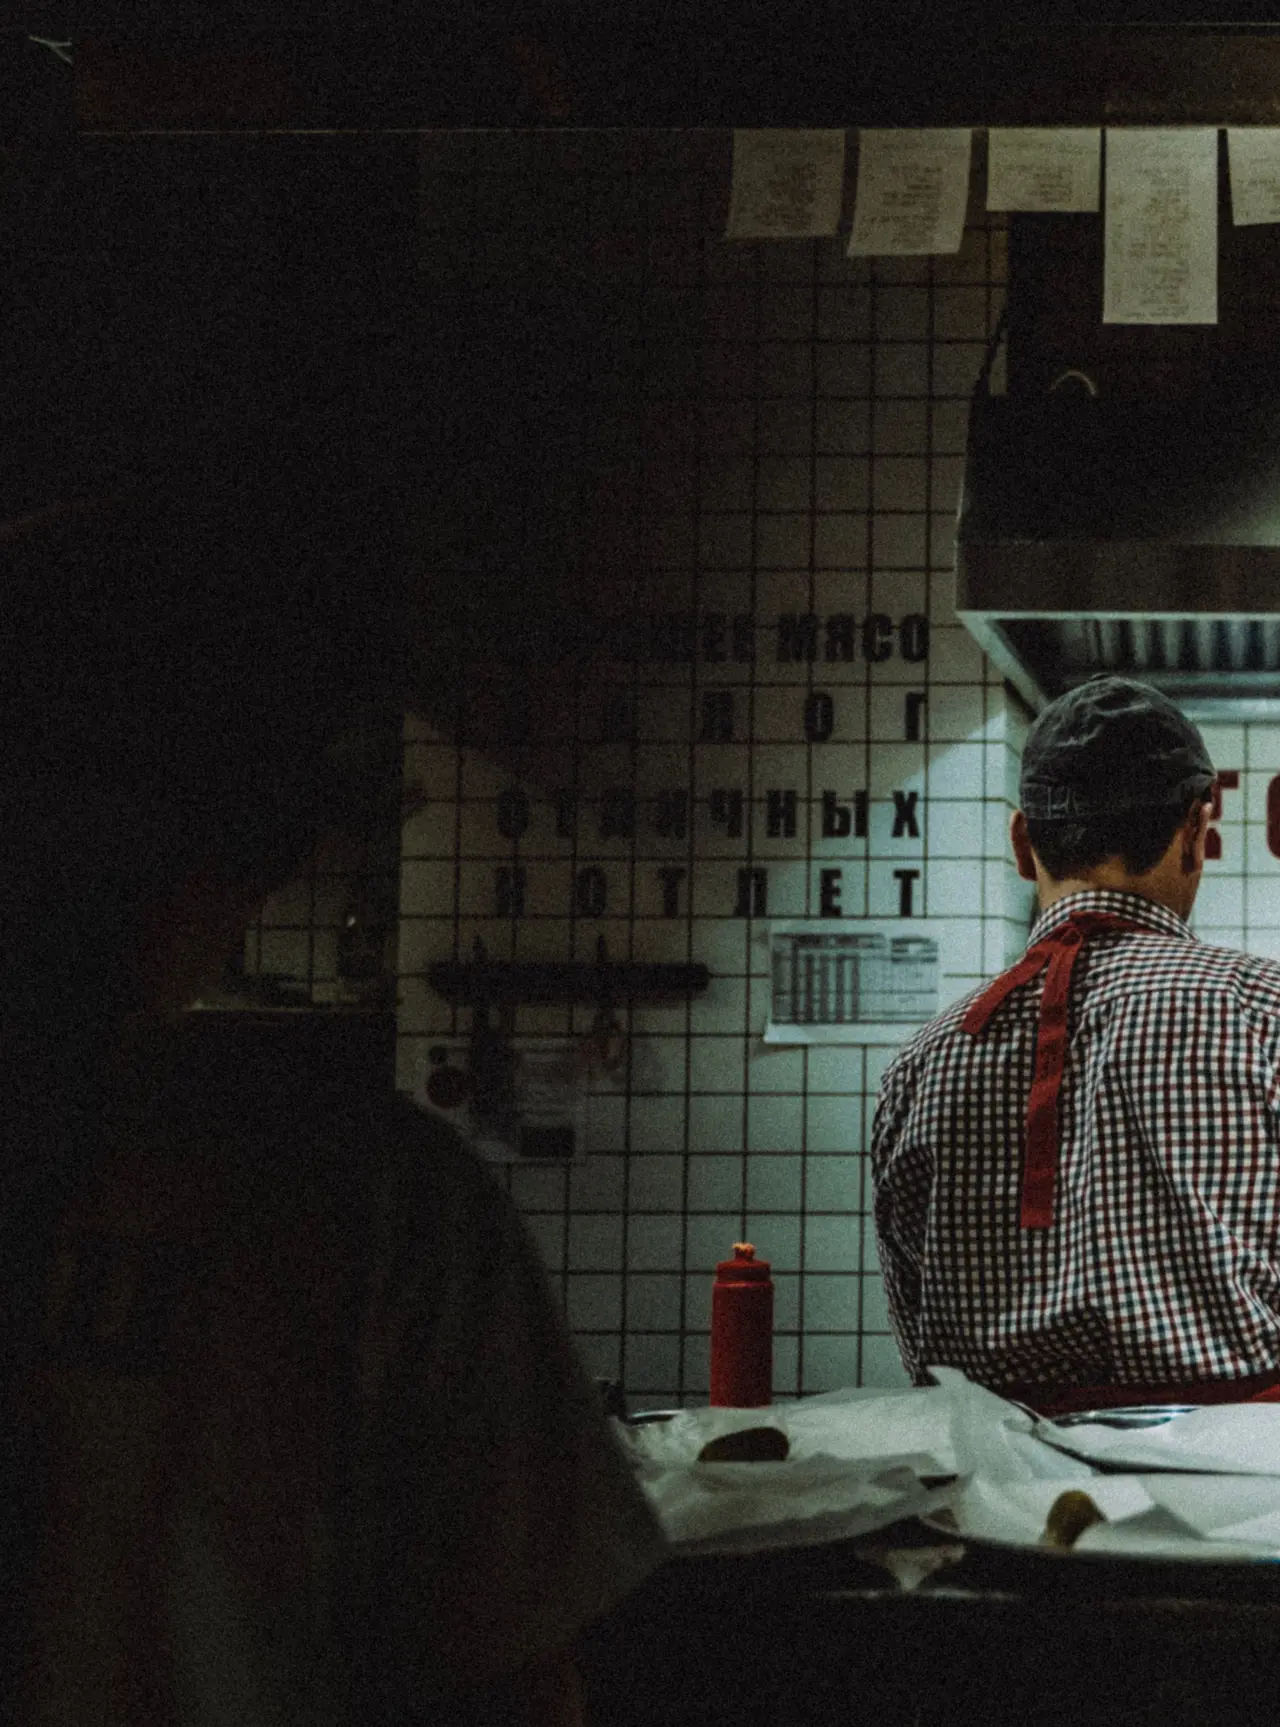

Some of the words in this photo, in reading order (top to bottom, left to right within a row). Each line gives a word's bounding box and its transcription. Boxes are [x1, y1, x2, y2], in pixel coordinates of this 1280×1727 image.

[776, 613, 930, 662] МЯСО
[497, 788, 920, 838] ОТЛИЧНЫХ
[494, 866, 920, 918] КОТЛЕТ
